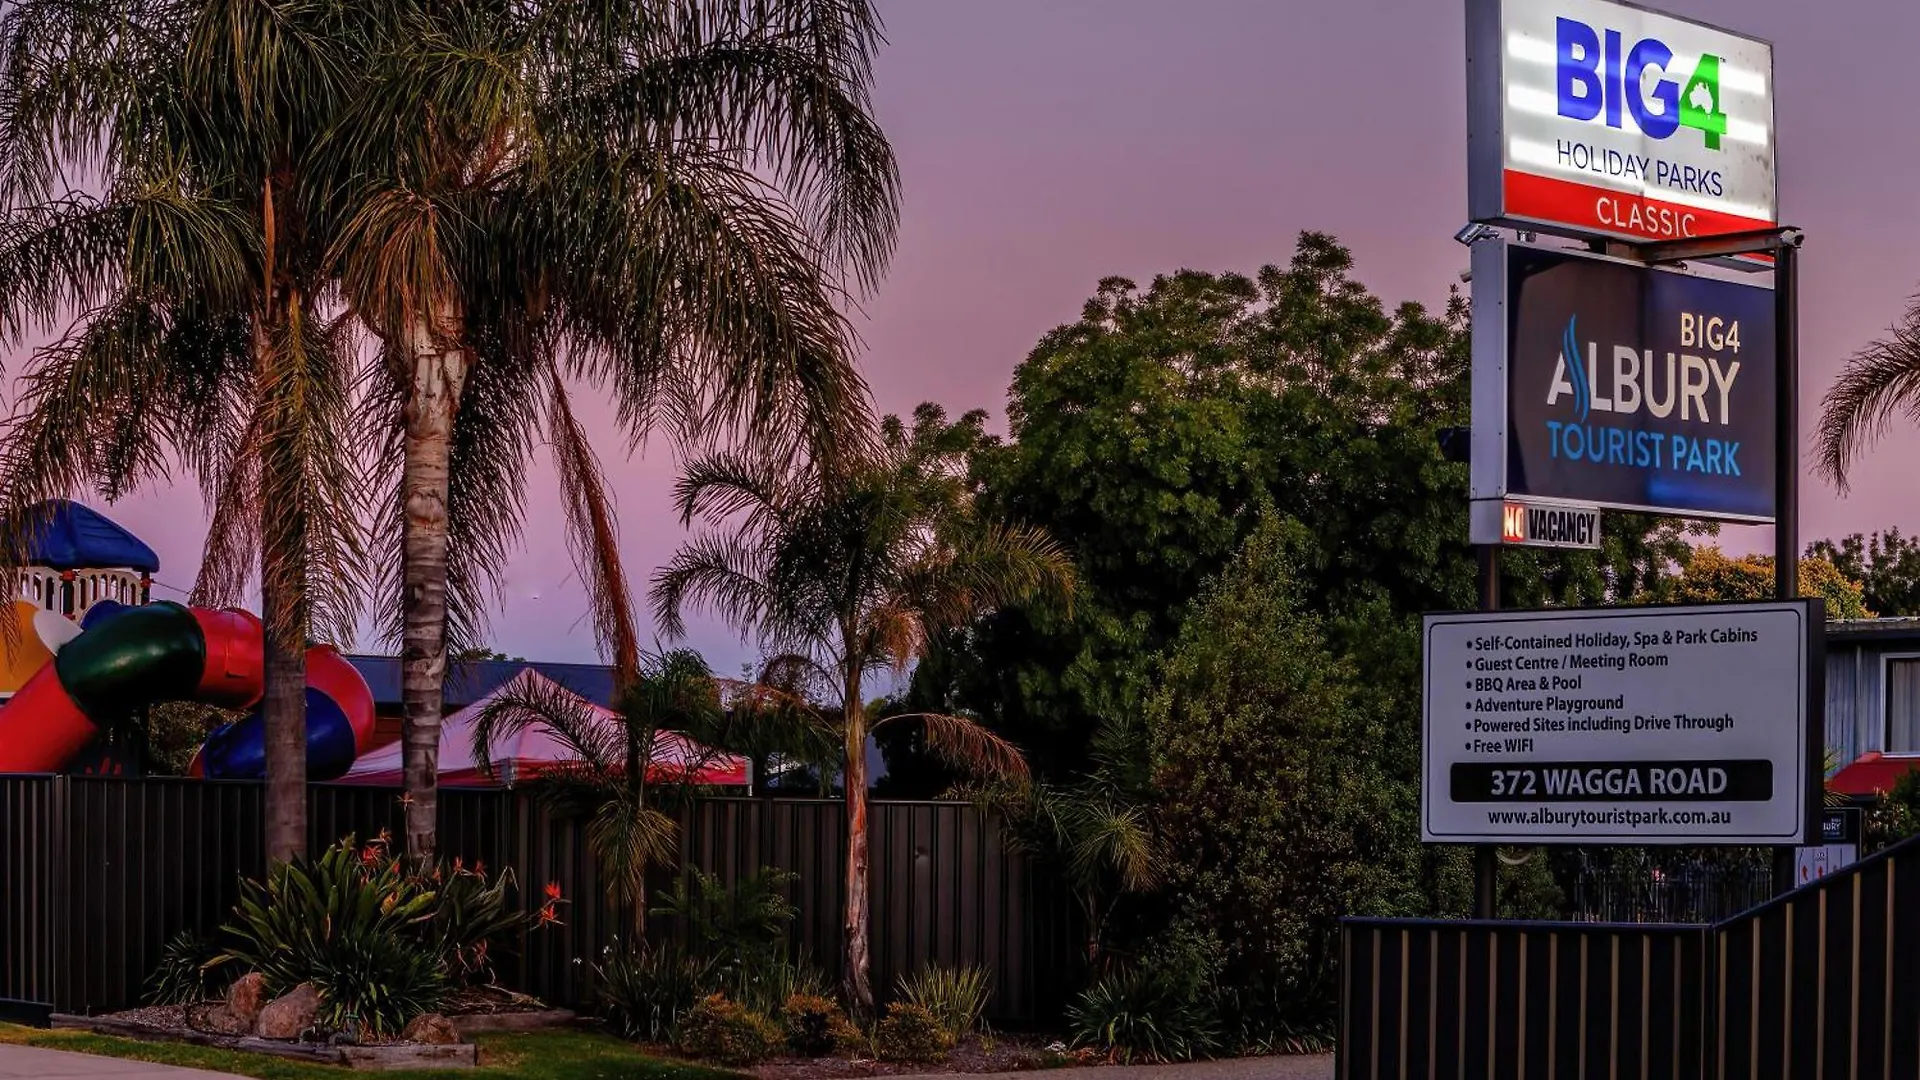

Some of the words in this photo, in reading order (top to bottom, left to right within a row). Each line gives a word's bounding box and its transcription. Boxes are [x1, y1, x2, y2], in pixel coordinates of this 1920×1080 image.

[1556, 16, 1727, 151] BIG4
[1556, 139, 1649, 178] HOLIDAY
[1656, 160, 1723, 197] PARKS
[1596, 196, 1697, 238] CLASSIC
[1681, 312, 1741, 353] BIG4
[1546, 340, 1741, 425] ALBURY
[1546, 421, 1664, 468] TOURIST
[1672, 435, 1741, 476] PARK
[1503, 505, 1525, 539] NO
[1528, 508, 1597, 545] VACANCY
[1475, 633, 1572, 651] Self-Contained
[1575, 631, 1631, 650] Holiday,
[1633, 631, 1660, 649] Spa
[1662, 630, 1673, 645] &
[1676, 628, 1708, 645] Park
[1710, 627, 1759, 644] Cabins
[1475, 657, 1513, 671] Guest
[1515, 655, 1559, 671] Centre
[1561, 654, 1568, 669] /
[1569, 653, 1625, 671] Meeting
[1628, 652, 1669, 667] Room
[1475, 677, 1503, 693] BBQ
[1506, 676, 1537, 691] Area
[1539, 675, 1550, 691] &
[1552, 674, 1582, 690] Pool
[1474, 696, 1543, 712] Adventure
[1546, 694, 1624, 714] Playground
[1474, 717, 1530, 733] Powered
[1532, 717, 1565, 732] Sites
[1567, 715, 1631, 734] including
[1634, 714, 1671, 730] Drive
[1673, 713, 1734, 732] Through
[1474, 739, 1502, 753] Free
[1504, 738, 1534, 753] WIFI
[1490, 769, 1537, 795] 372
[1543, 768, 1643, 795] WAGGA
[1650, 767, 1727, 795] ROAD
[1487, 807, 1732, 828] www.alburytouristpark.com.au
